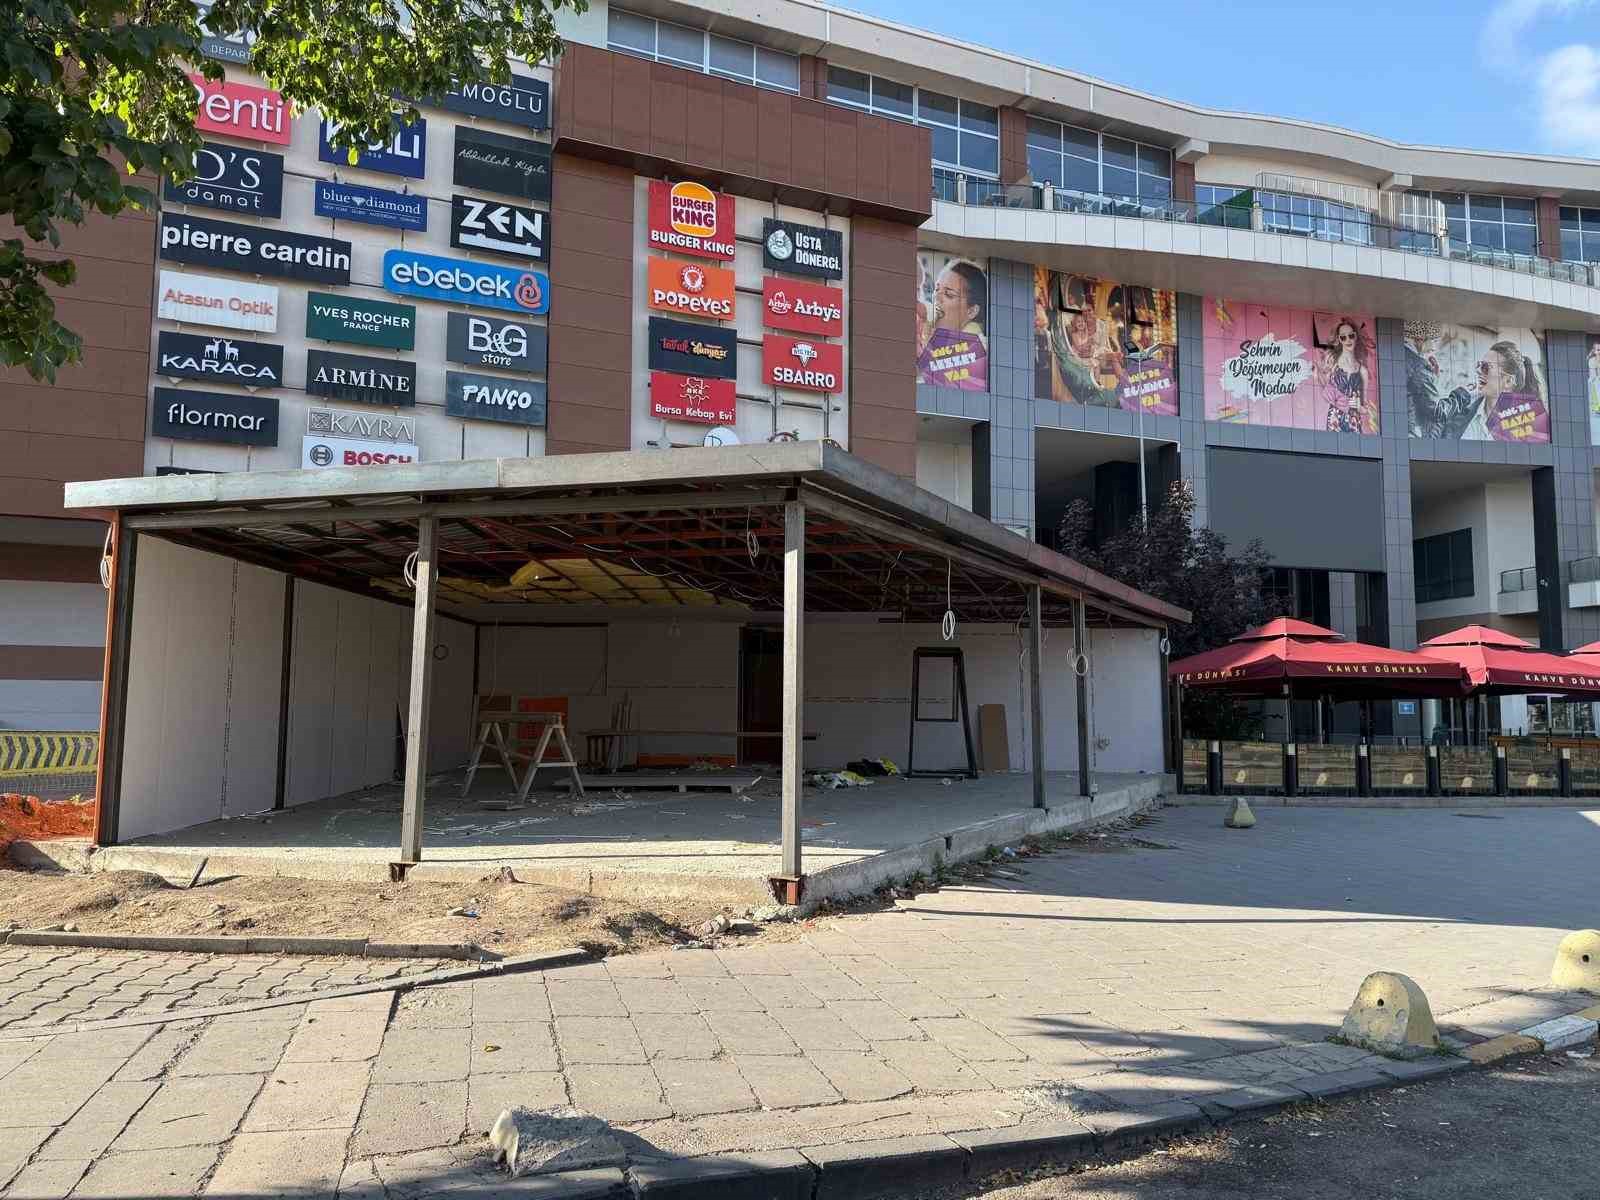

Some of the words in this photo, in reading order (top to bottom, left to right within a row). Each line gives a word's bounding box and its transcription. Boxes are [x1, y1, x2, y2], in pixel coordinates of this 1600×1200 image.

[192, 149, 261, 189] D'S
[187, 186, 261, 209] damat
[322, 188, 351, 203] blue
[366, 196, 420, 215] diamond
[672, 196, 715, 213] BURGER
[460, 200, 543, 240] ZEN
[672, 207, 715, 228] KING
[162, 223, 251, 256] pierre
[259, 241, 351, 271] cardin
[651, 229, 701, 250] BURGER
[703, 240, 735, 256] KING
[795, 231, 822, 251] USTA
[391, 261, 512, 299] ebebek
[163, 288, 224, 309] Atasun
[228, 297, 275, 317] Optik
[793, 298, 842, 322] Arby's
[313, 305, 349, 319] YVES
[353, 311, 410, 328] ROCHER
[343, 321, 380, 332] FRANCE
[468, 318, 527, 357] B&G
[161, 353, 277, 380] KARACA
[481, 353, 512, 366] store
[773, 366, 836, 388] SBARRO
[462, 385, 532, 411] PANÇO
[167, 403, 265, 431] flormar
[655, 403, 682, 415] Bursa
[685, 407, 715, 421] Kebap
[719, 410, 733, 421] Evi
[330, 412, 412, 442] KAYRA
[1326, 664, 1368, 673] KAHVE
[1375, 663, 1428, 674] DÜNYASI
[1524, 673, 1565, 684] KAHVE
